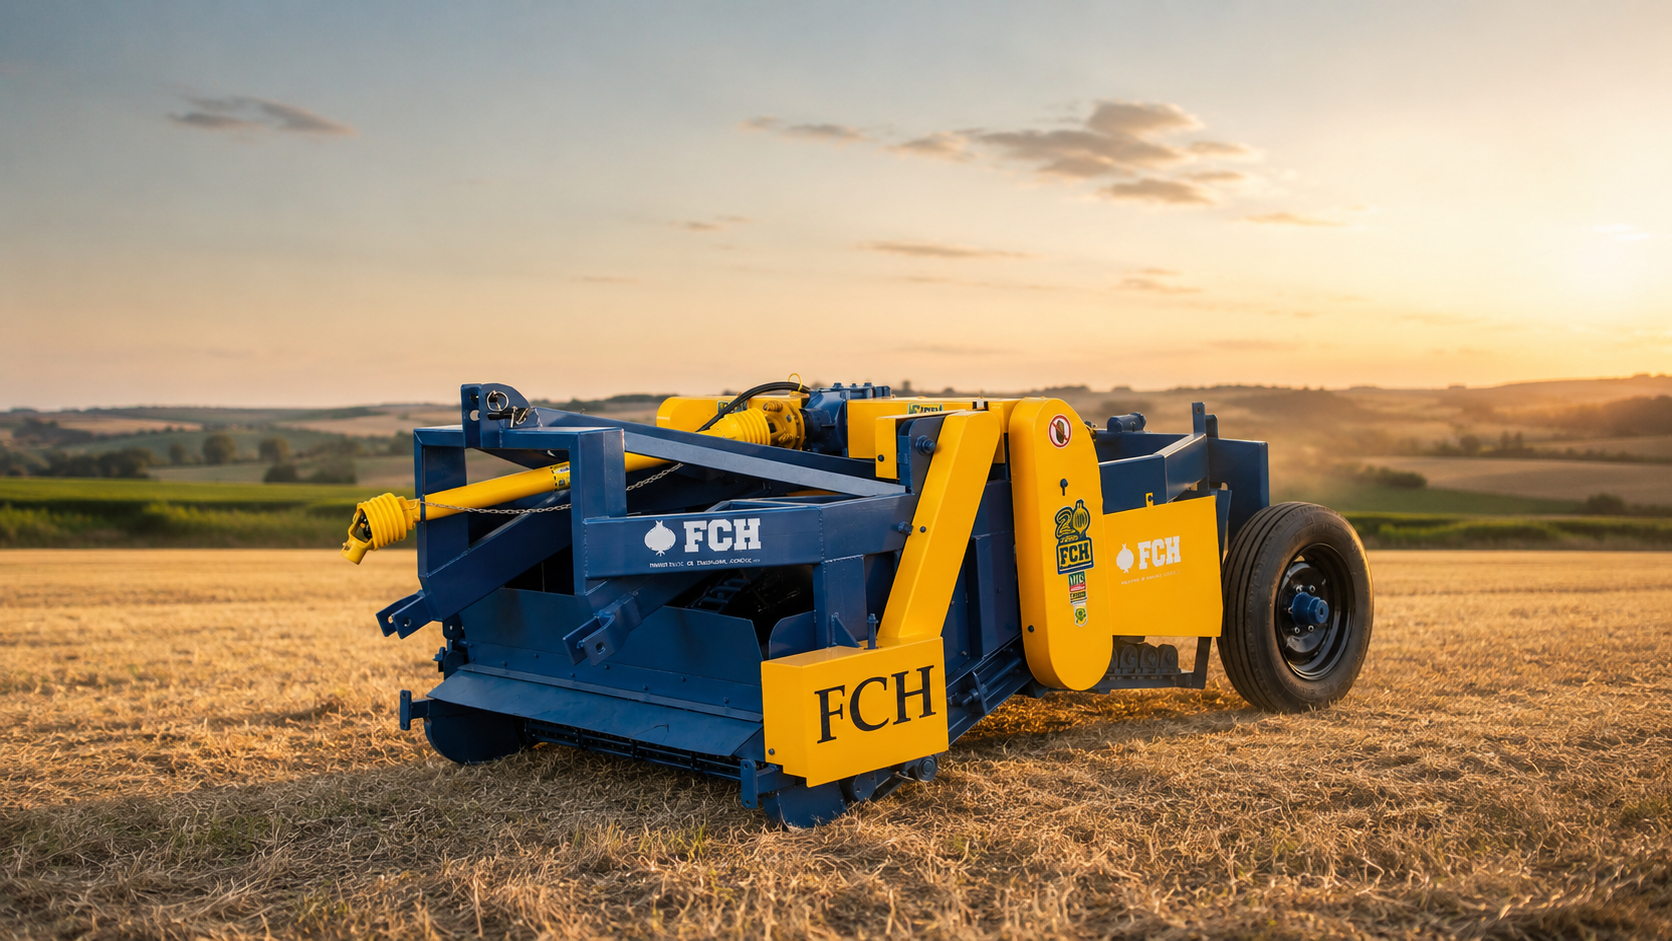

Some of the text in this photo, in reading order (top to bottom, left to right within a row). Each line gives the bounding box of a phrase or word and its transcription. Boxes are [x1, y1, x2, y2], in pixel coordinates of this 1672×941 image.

[683, 518, 761, 553] FCH
[1137, 535, 1181, 570] FCH
[1060, 542, 1089, 565] FCH
[814, 665, 936, 744] FCH
